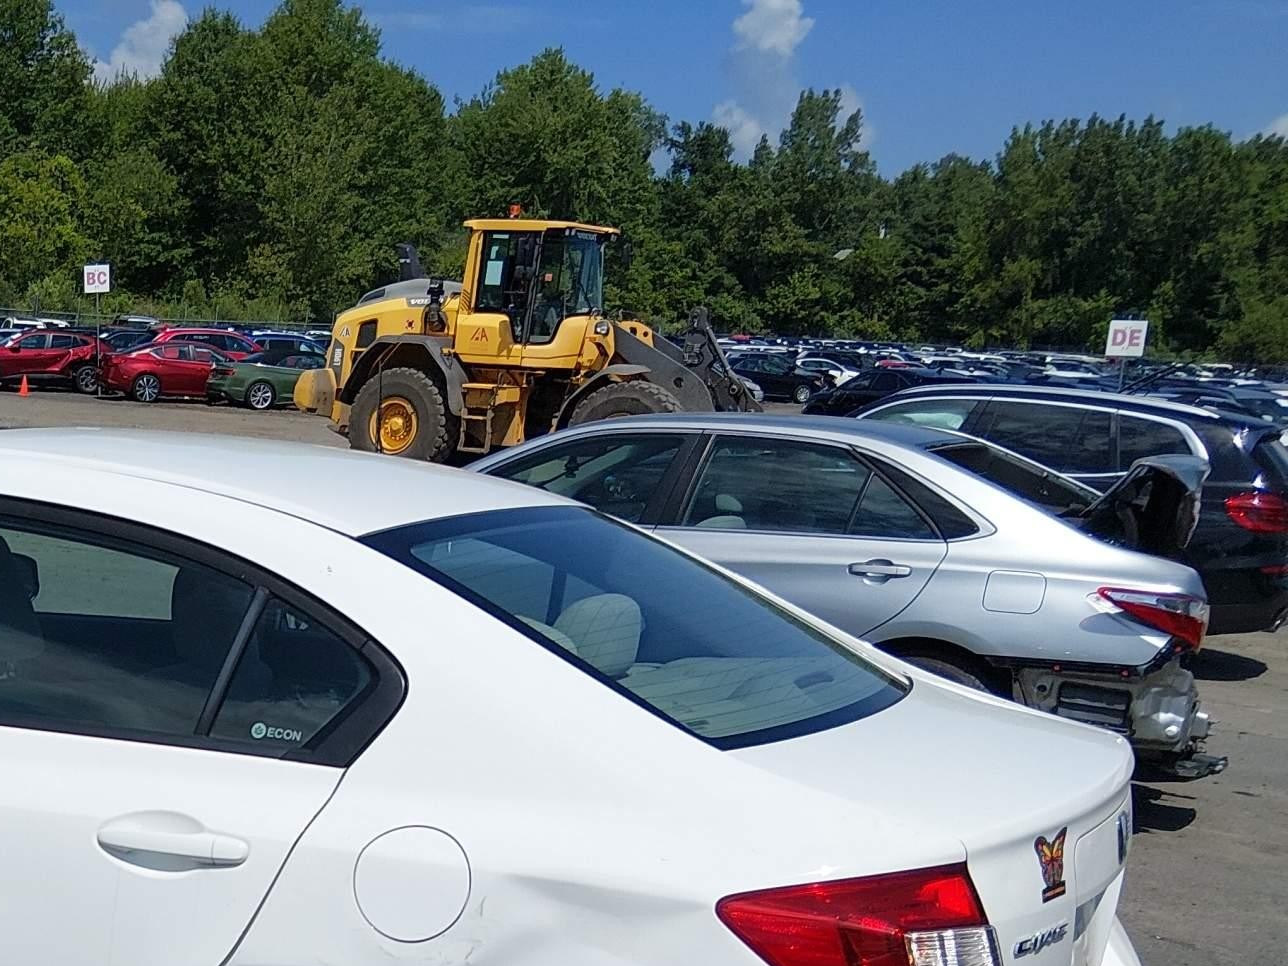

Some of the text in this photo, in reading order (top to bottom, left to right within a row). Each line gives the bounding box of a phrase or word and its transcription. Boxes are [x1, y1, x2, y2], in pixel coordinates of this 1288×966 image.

[86, 271, 107, 286] BC
[1112, 328, 1142, 347] DE
[266, 727, 302, 741] ECON
